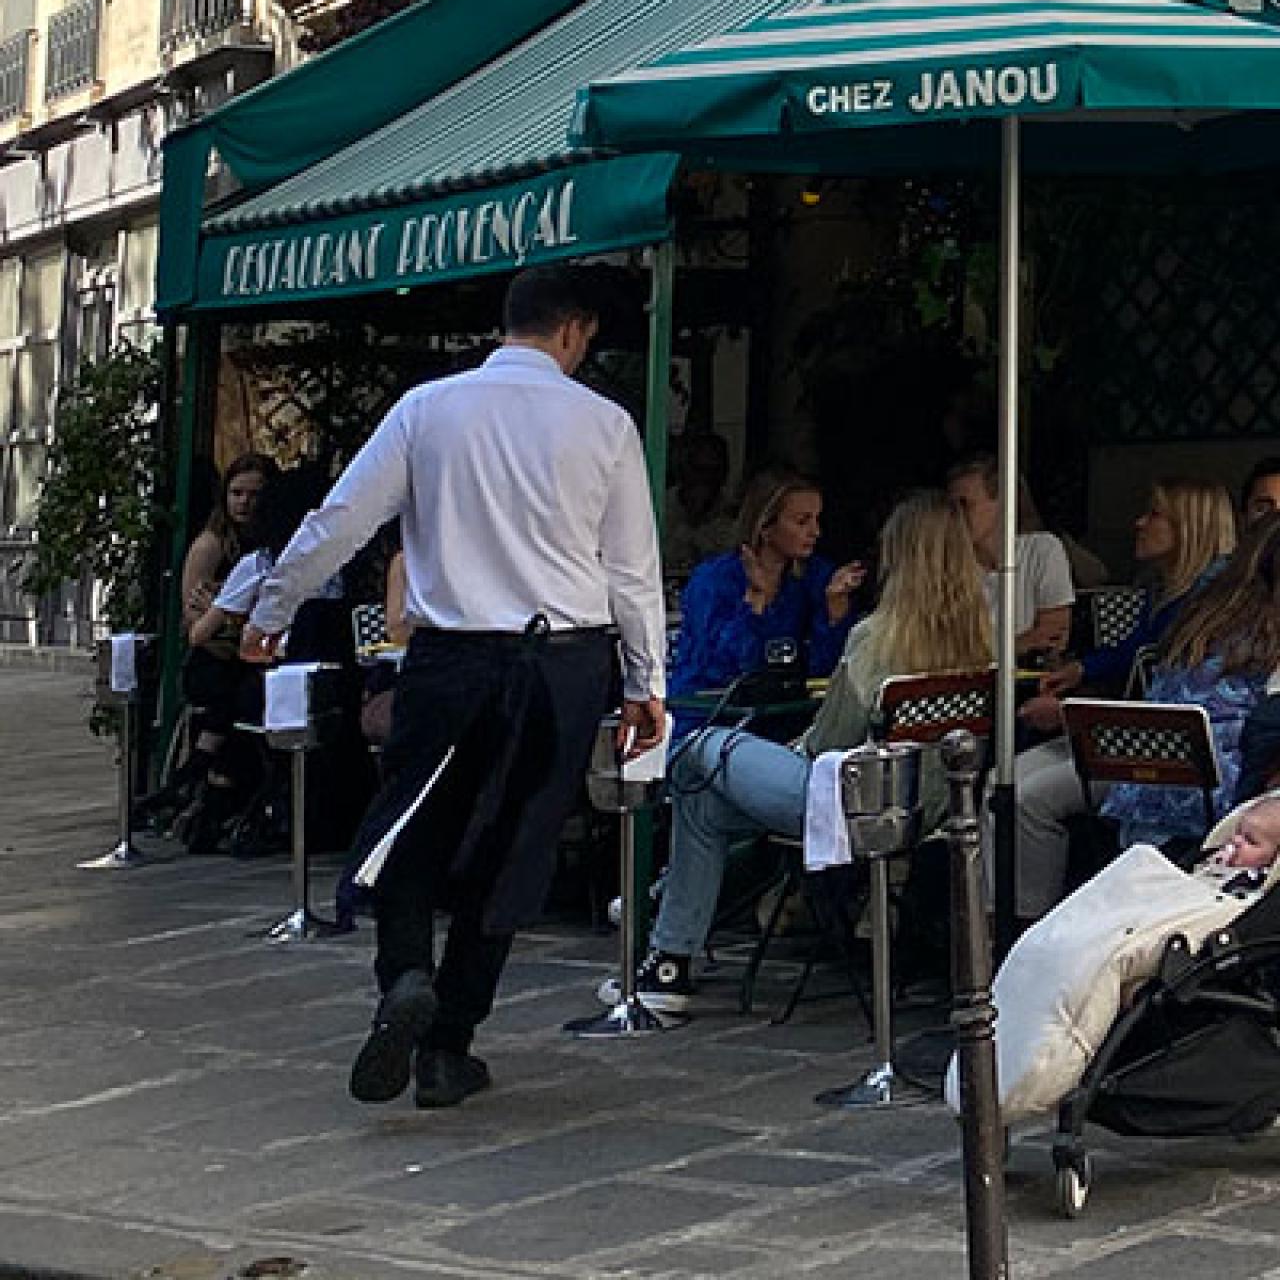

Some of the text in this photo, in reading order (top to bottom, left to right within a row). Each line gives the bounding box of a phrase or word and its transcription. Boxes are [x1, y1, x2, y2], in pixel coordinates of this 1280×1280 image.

[806, 63, 1059, 114] CHEZ JANOU
[222, 179, 579, 295] RESTAURANT PROVENÇAL
